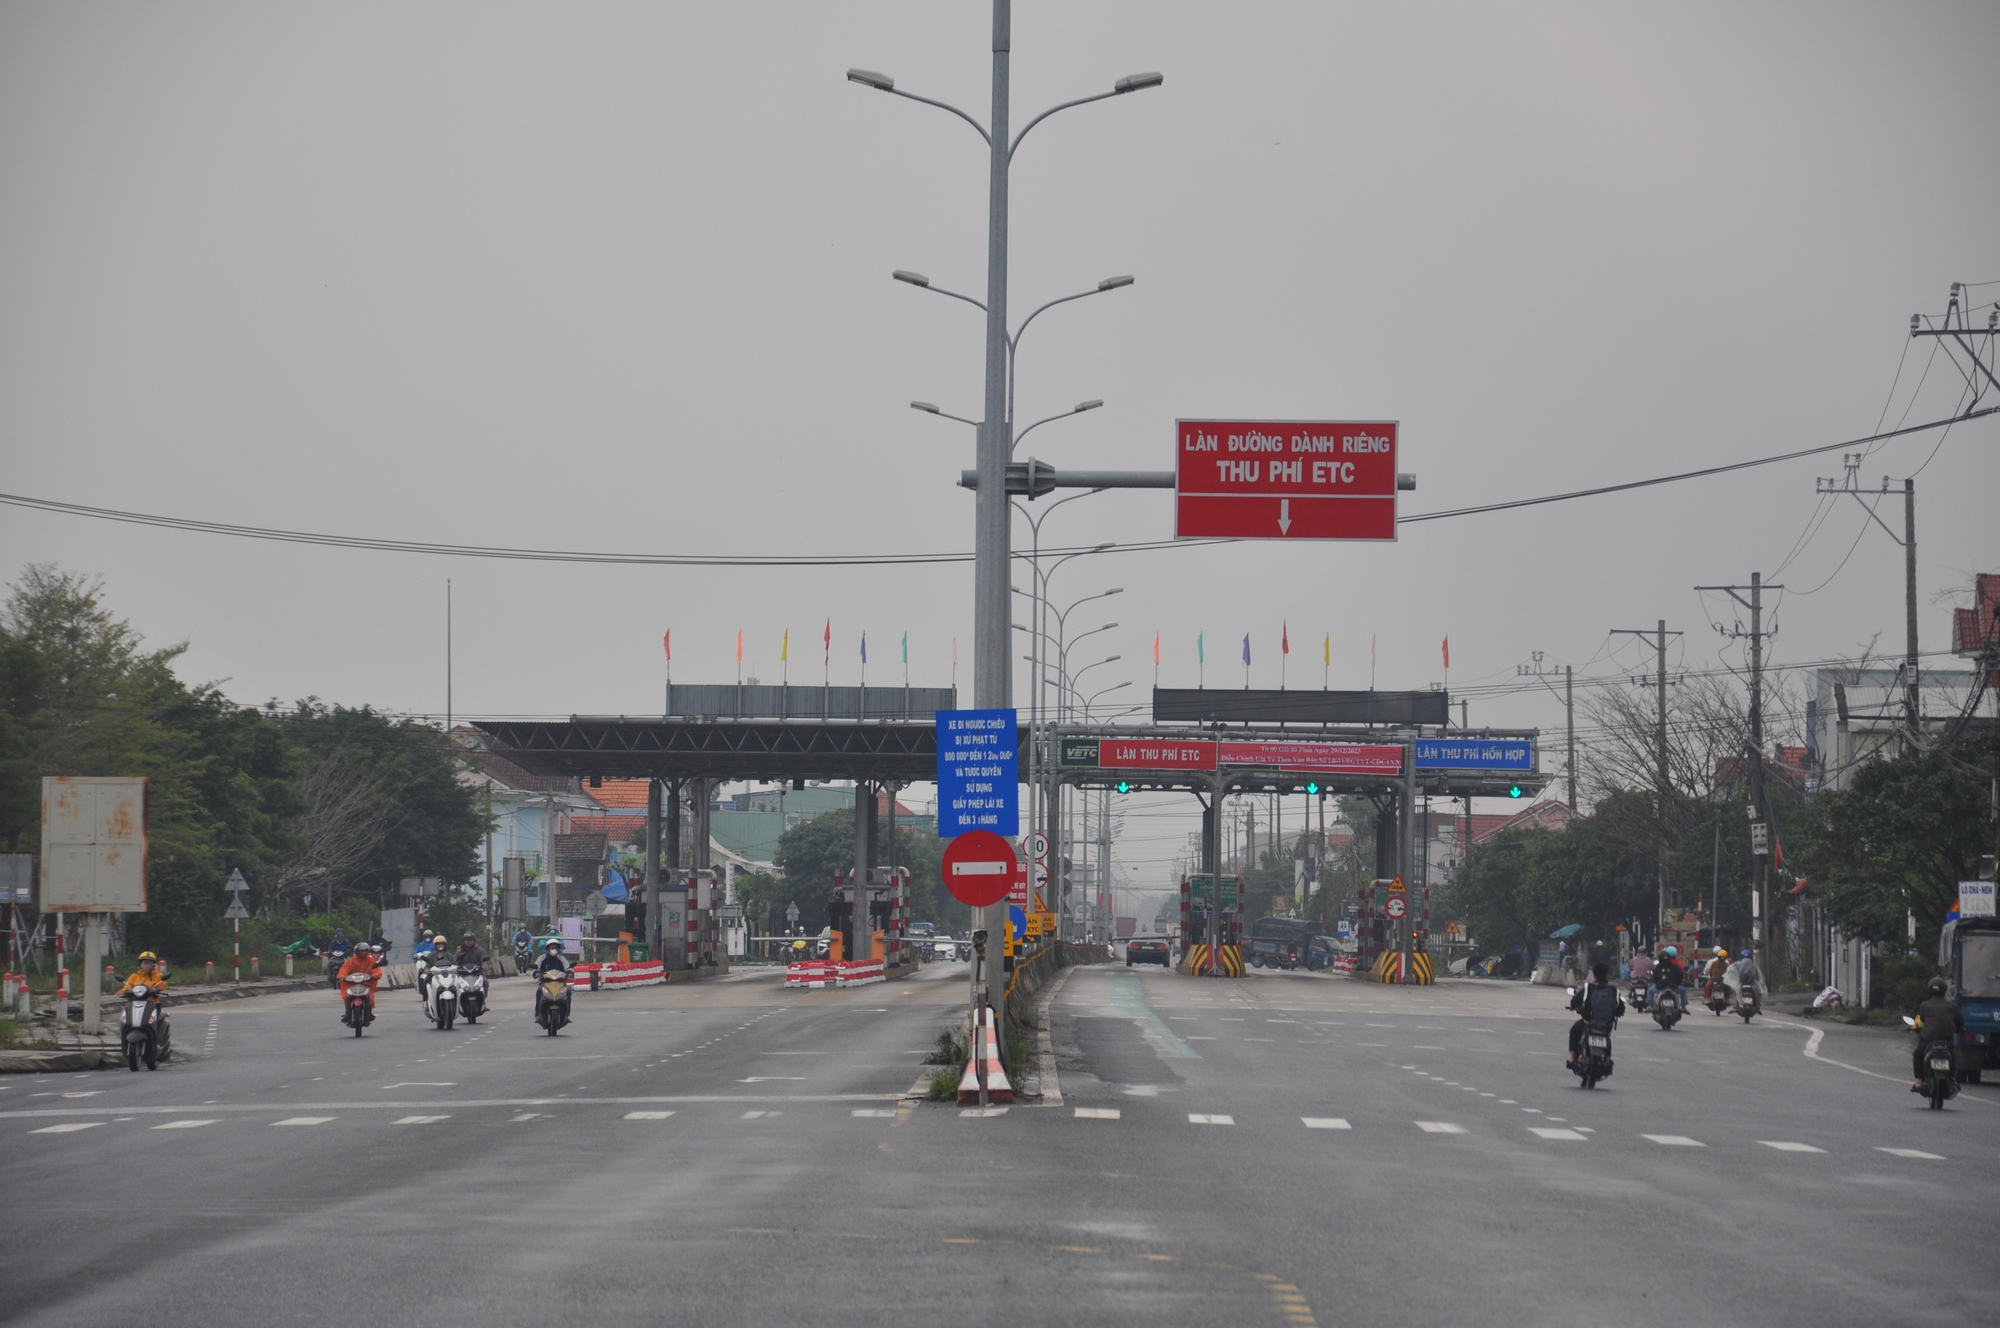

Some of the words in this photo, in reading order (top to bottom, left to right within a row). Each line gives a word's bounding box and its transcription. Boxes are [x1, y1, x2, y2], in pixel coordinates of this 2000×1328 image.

[1185, 430, 1218, 452] LÀN
[1228, 430, 1283, 453] ĐƯỜNG
[1291, 431, 1334, 453] DÀNH
[1342, 432, 1390, 453] RIÊNG
[1216, 460, 1260, 483] THU
[1269, 457, 1303, 483] PHÍ
[1312, 461, 1355, 483] ETC
[948, 720, 957, 730] XE
[957, 720, 965, 730] ĐI
[955, 736, 962, 746] BỊ
[972, 735, 988, 747] PHẠT
[944, 751, 956, 761] 800
[969, 747, 982, 761] ĐẾN
[983, 751, 987, 760] 1
[1066, 747, 1098, 758] VETC
[1116, 745, 1137, 760] LÀN
[1140, 748, 1159, 760] THU
[1162, 747, 1178, 761] PHÍ
[1181, 749, 1200, 761] ETC
[1417, 744, 1438, 759] LÀN
[1440, 748, 1461, 760] THU
[1463, 747, 1479, 760] PHÍ
[1505, 747, 1525, 762] HỢP
[955, 764, 964, 777] VÀ
[964, 764, 980, 777] TƯỚC
[981, 763, 1002, 777] QUYỀN
[975, 783, 993, 794] DỤNG
[952, 795, 967, 809] GIẤY
[967, 796, 984, 809] PHÉP
[984, 796, 995, 809] LÁI
[995, 799, 1004, 809] XE
[958, 811, 971, 825] ĐẾN
[972, 815, 976, 825] 3
[977, 812, 998, 825] THÁNG
